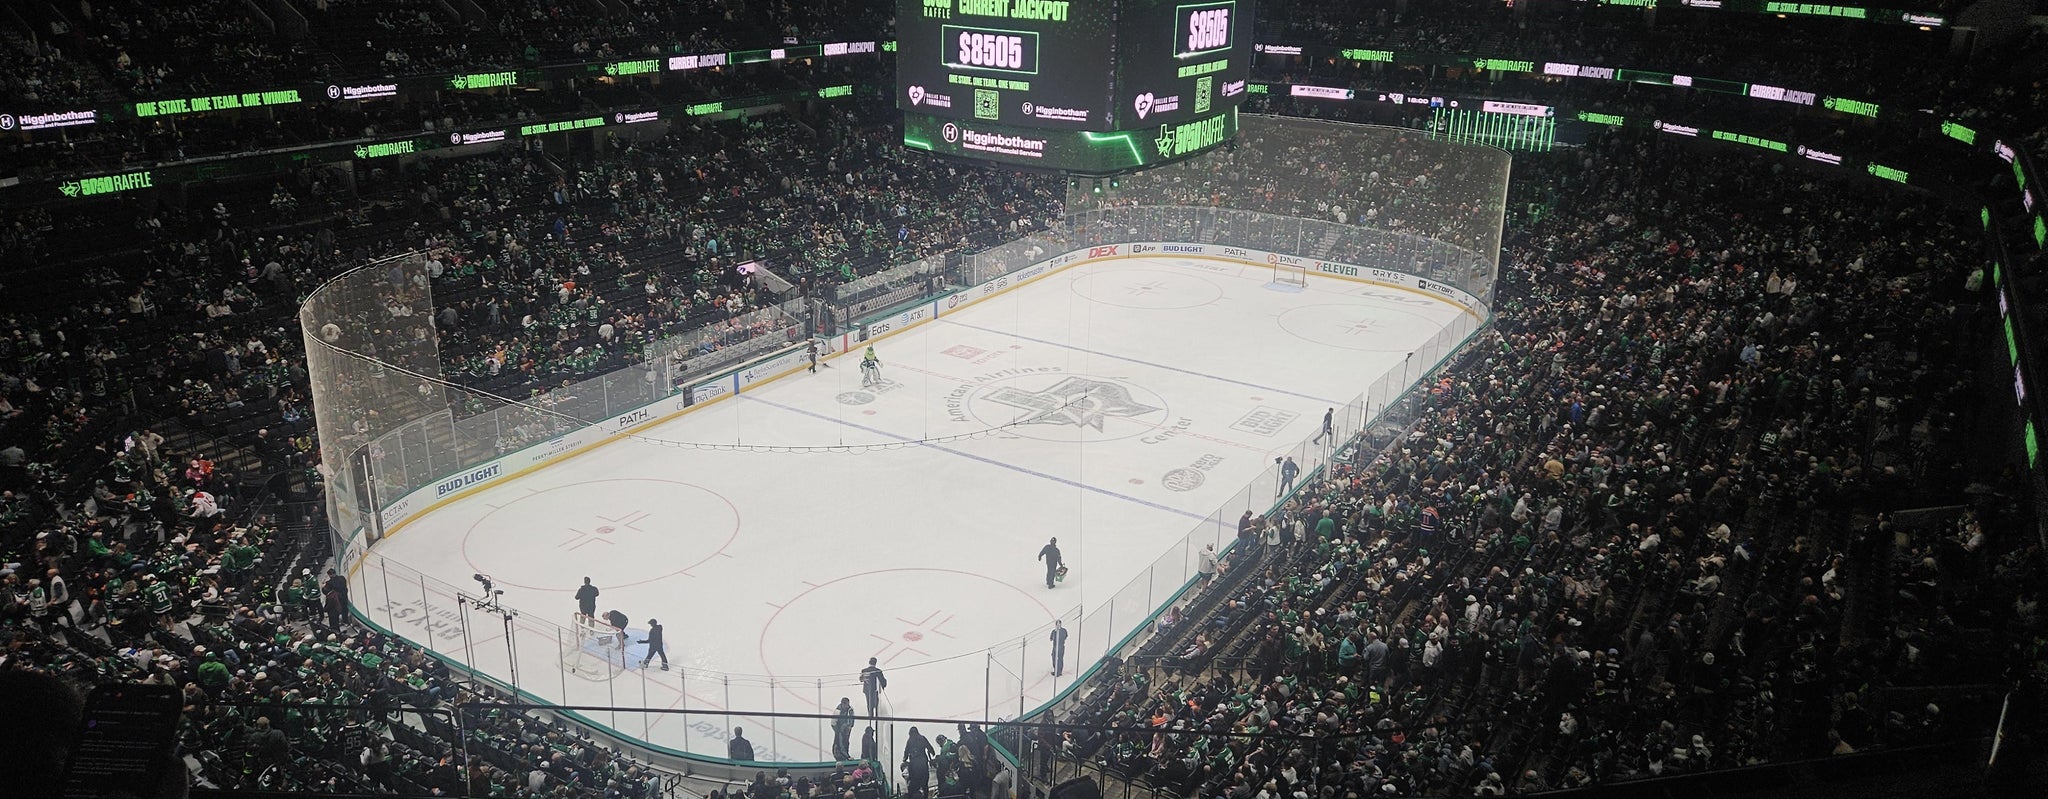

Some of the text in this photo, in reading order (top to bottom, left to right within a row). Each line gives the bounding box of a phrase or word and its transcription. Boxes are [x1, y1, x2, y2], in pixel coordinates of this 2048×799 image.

[924, 7, 950, 19] RAFFLE
[958, 0, 1069, 21] CURRENT JACKPOT
[1188, 8, 1228, 51] $8505
[960, 32, 1022, 69] $8505
[698, 53, 726, 68] JACKPOT
[1579, 66, 1614, 80] JACKPOT
[343, 84, 396, 95] Higginbotham
[136, 90, 302, 117] ONE STATE. ONE TEAM. ONE WINNER.
[19, 110, 94, 126] Higginbotham
[1036, 106, 1086, 118] Higginbotham
[1201, 114, 1225, 148] RAFFLE
[963, 130, 1042, 150] Higginbotham
[114, 172, 152, 191] RAFFLE
[1088, 245, 1119, 259] DEX
[1224, 248, 1246, 256] PATH
[910, 309, 924, 322] AT&T
[872, 322, 890, 336] Eats
[710, 385, 726, 398] Bank
[620, 409, 647, 426] PATH
[1140, 416, 1193, 445] Center
[438, 464, 499, 496] BUD LIGHT
[156, 592, 168, 602] 21
